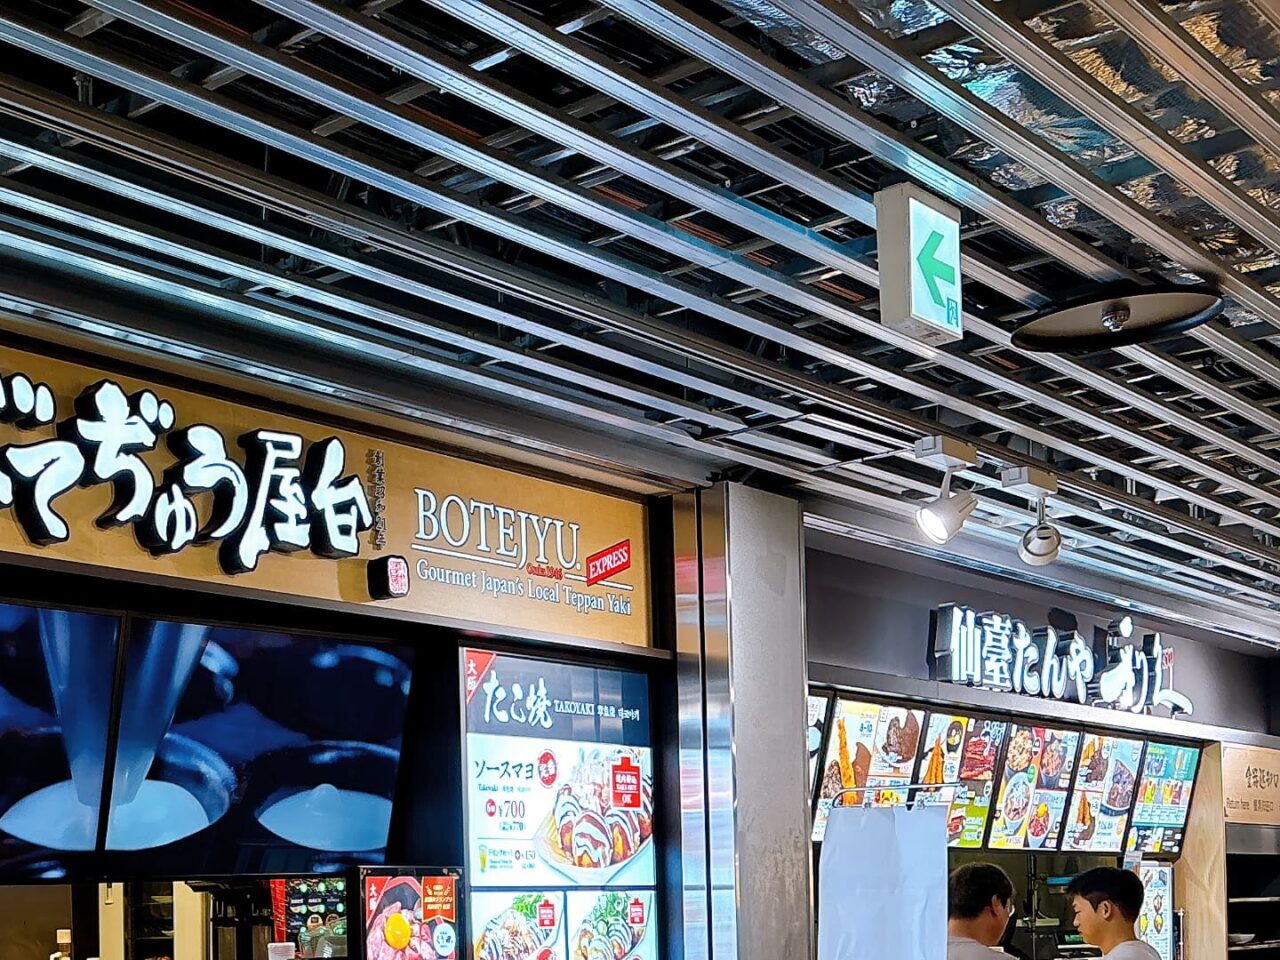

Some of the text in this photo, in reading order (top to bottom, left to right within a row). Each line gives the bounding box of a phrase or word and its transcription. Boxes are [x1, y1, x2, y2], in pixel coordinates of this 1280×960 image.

[588, 546, 629, 579] EXPRESS
[417, 558, 478, 588] Gourmet
[480, 569, 524, 597] Japan's
[528, 574, 560, 604] Local
[564, 584, 605, 613] Teppan
[606, 591, 632, 615] Yaki
[467, 659, 478, 691] 大阪
[482, 669, 554, 729] たこ焼
[553, 699, 596, 716] TAKOYAKI
[474, 759, 535, 781] ソースマヨ
